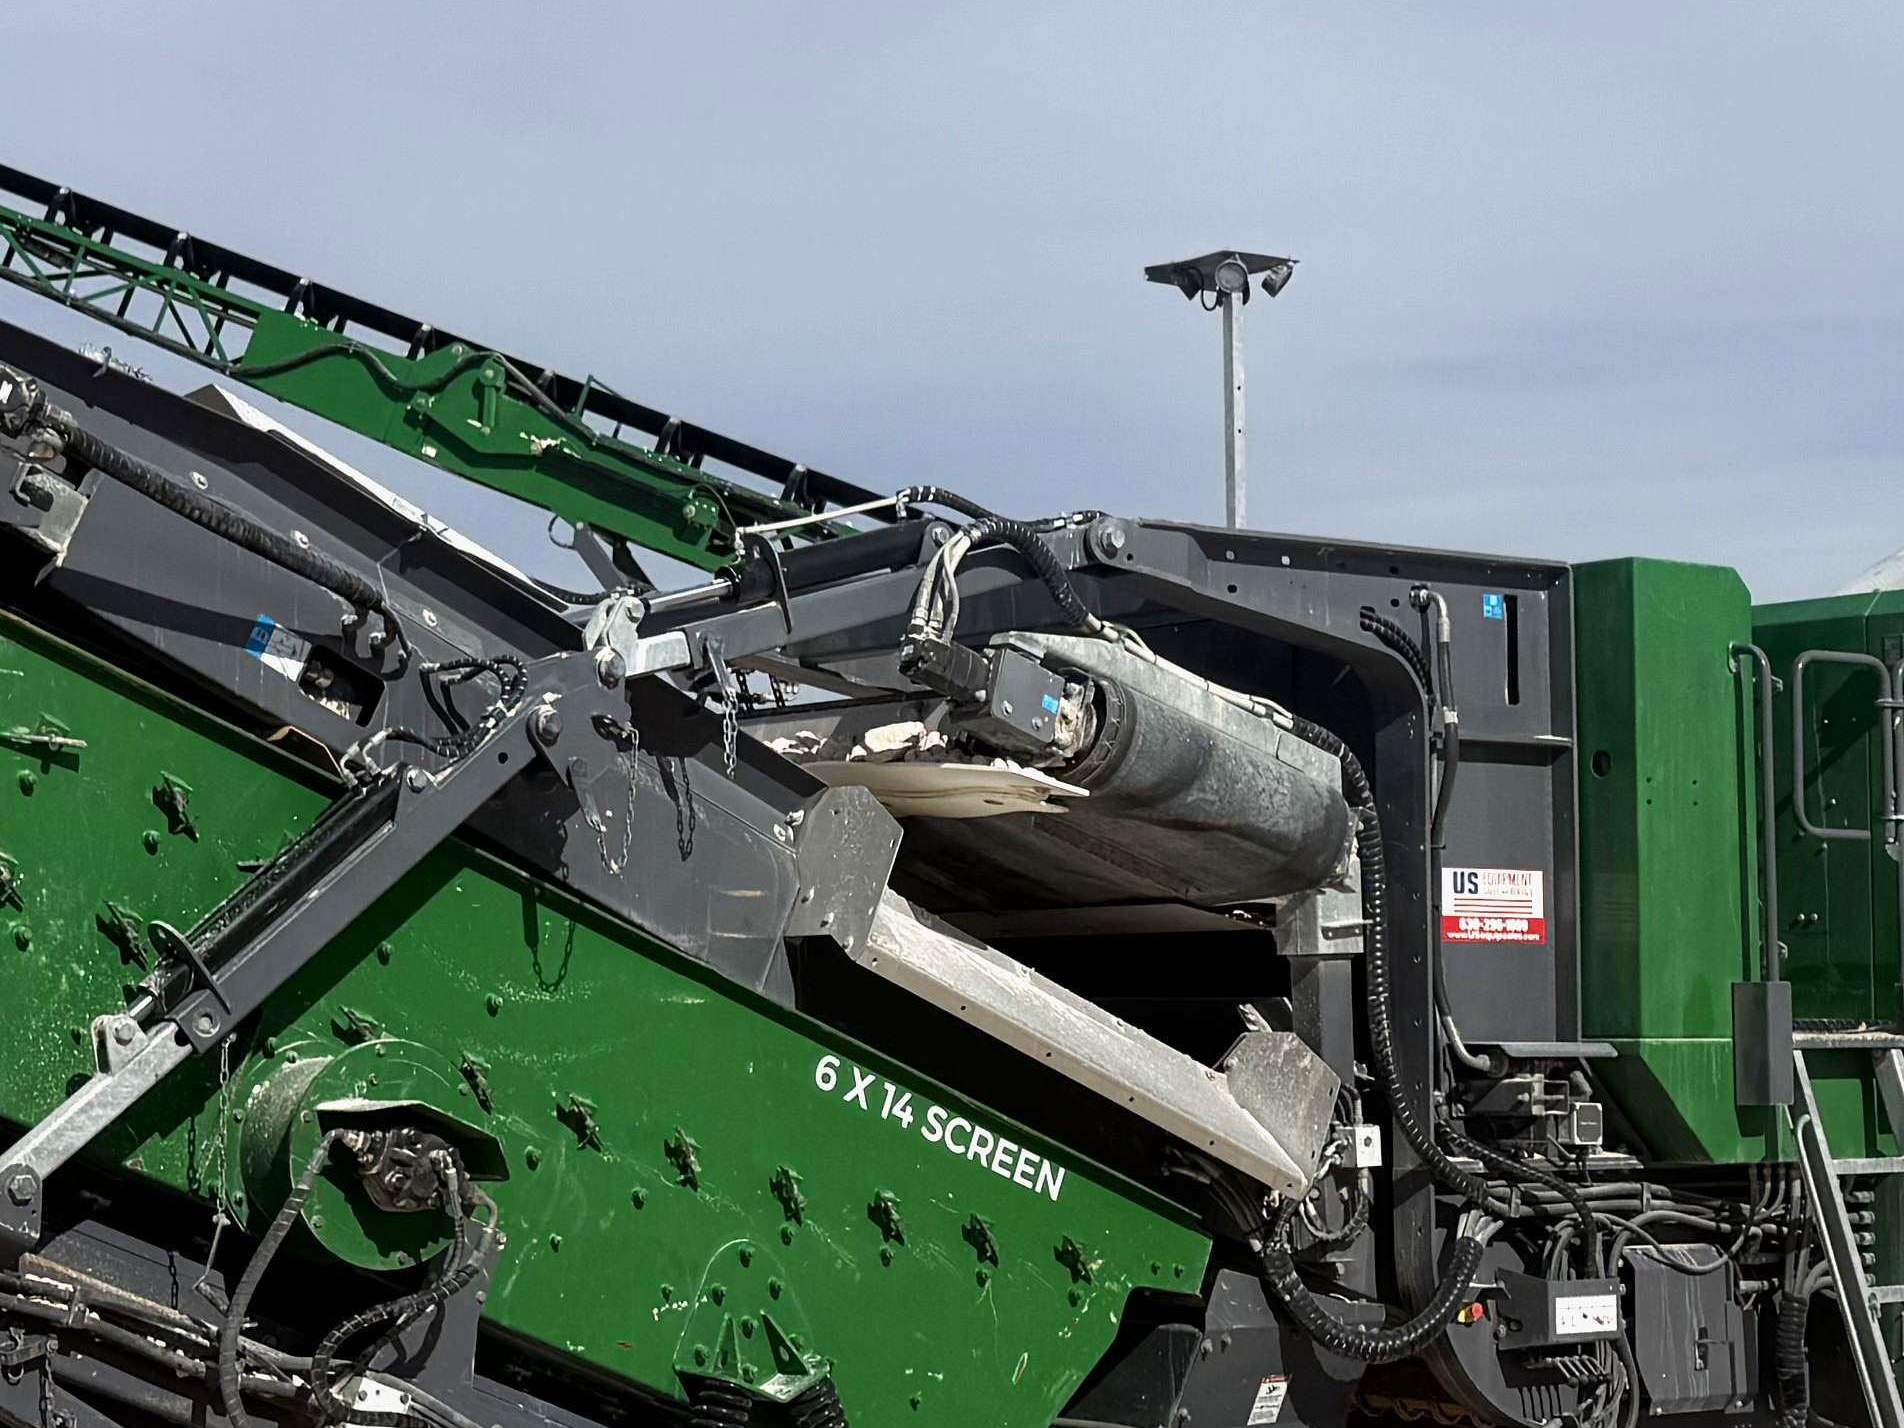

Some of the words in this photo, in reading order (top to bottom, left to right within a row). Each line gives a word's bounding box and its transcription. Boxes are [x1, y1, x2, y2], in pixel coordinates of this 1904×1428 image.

[1452, 871, 1479, 895] US
[815, 1054, 841, 1092] 6
[843, 1066, 876, 1111] X
[881, 1081, 914, 1129] 14
[920, 1104, 1066, 1202] SCREEN
